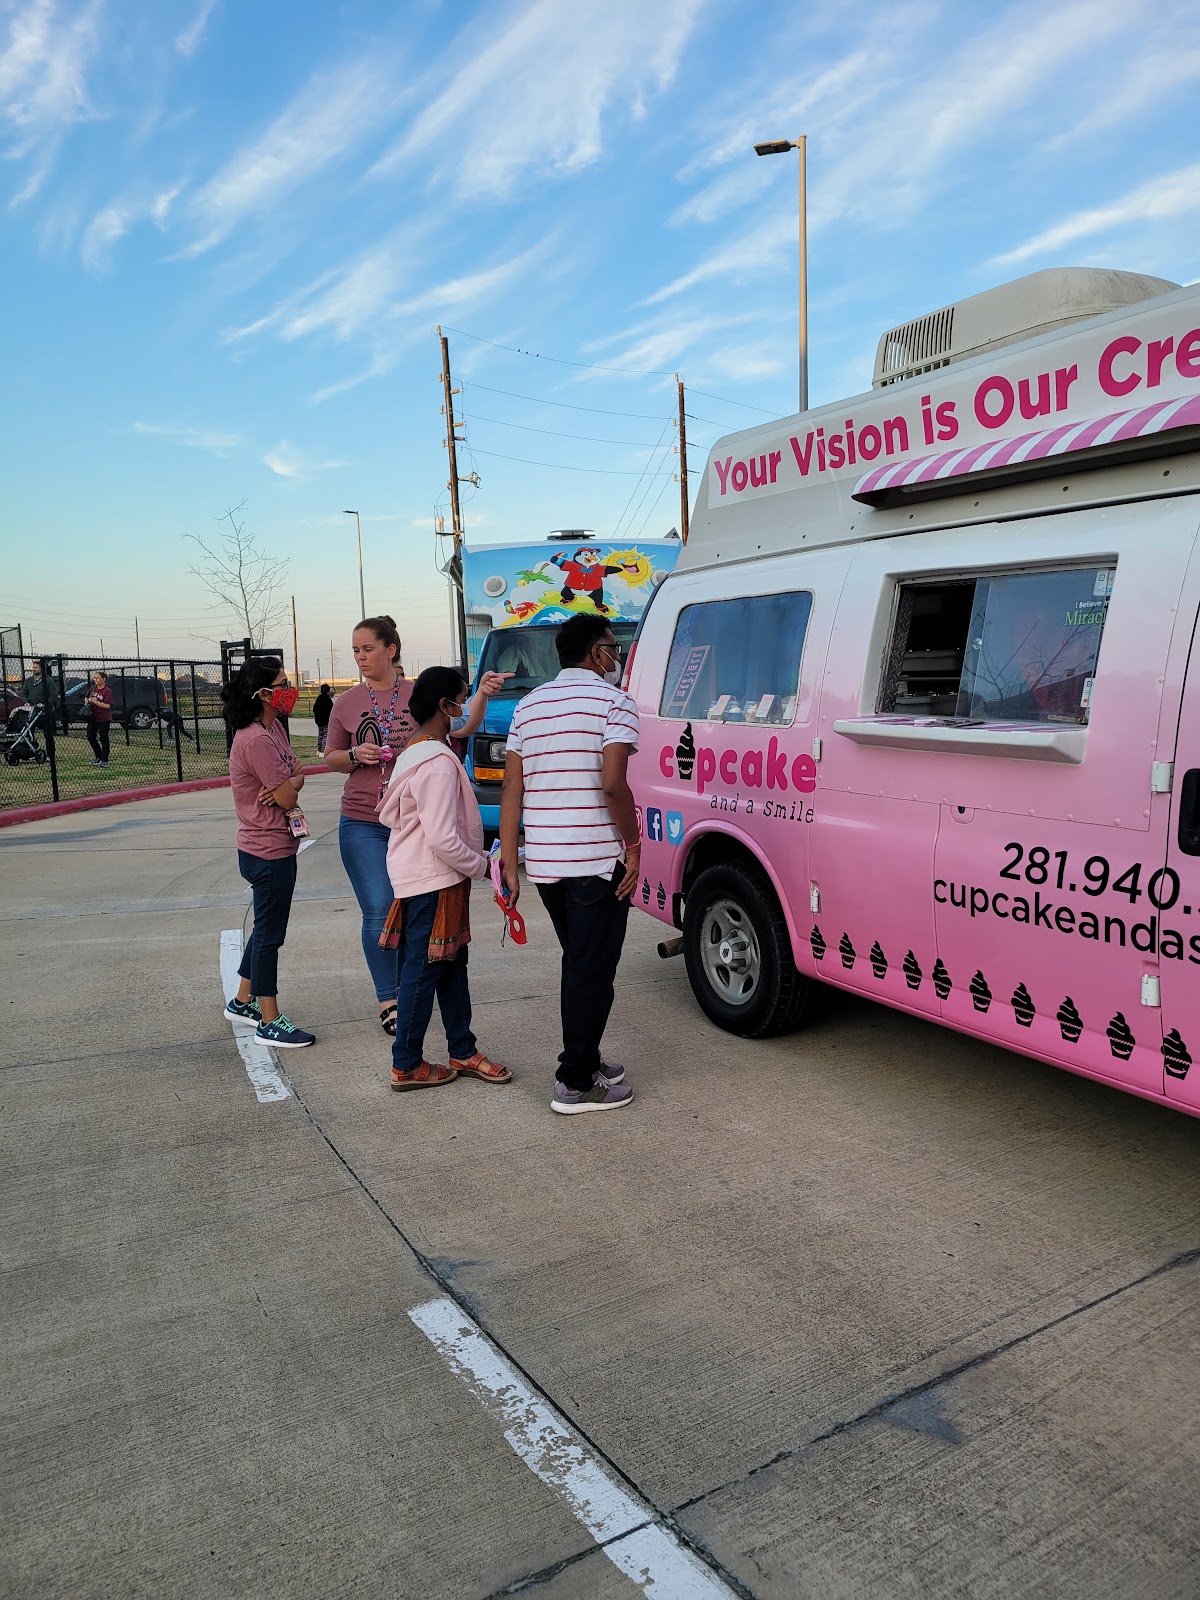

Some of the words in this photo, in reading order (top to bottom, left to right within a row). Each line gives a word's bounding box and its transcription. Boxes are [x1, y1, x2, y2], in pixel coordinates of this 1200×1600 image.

[713, 450, 782, 496] Your
[789, 418, 910, 477] Vision
[920, 394, 960, 441] is
[973, 363, 1078, 429] Our
[1079, 600, 1103, 608] Believe
[710, 792, 740, 813] and
[745, 799, 754, 814] a
[999, 841, 1200, 915] 281.940.
